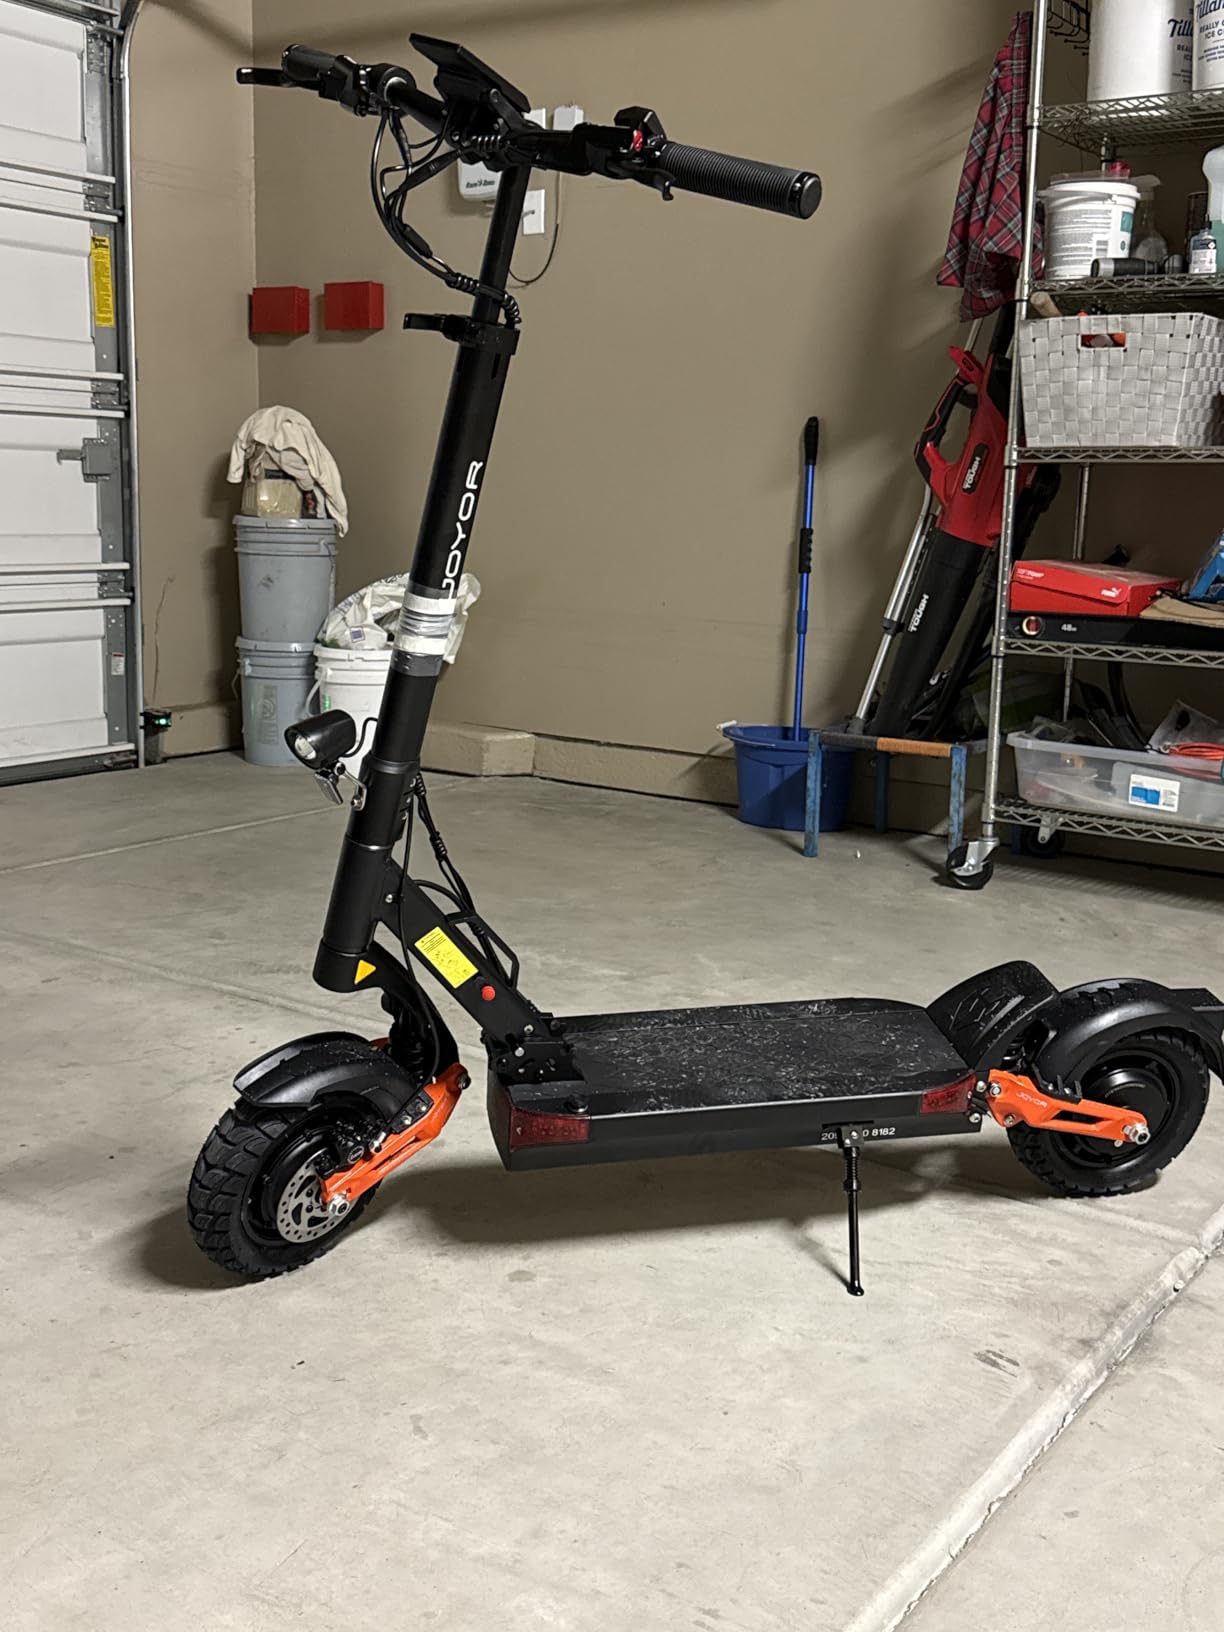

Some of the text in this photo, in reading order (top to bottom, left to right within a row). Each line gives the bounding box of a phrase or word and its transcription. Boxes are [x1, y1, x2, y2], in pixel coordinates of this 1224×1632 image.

[441, 460, 484, 599] JOYOR
[910, 593, 929, 632] TOUGH
[1015, 1091, 1048, 1109] JOYOR
[871, 1127, 896, 1137] 8182
